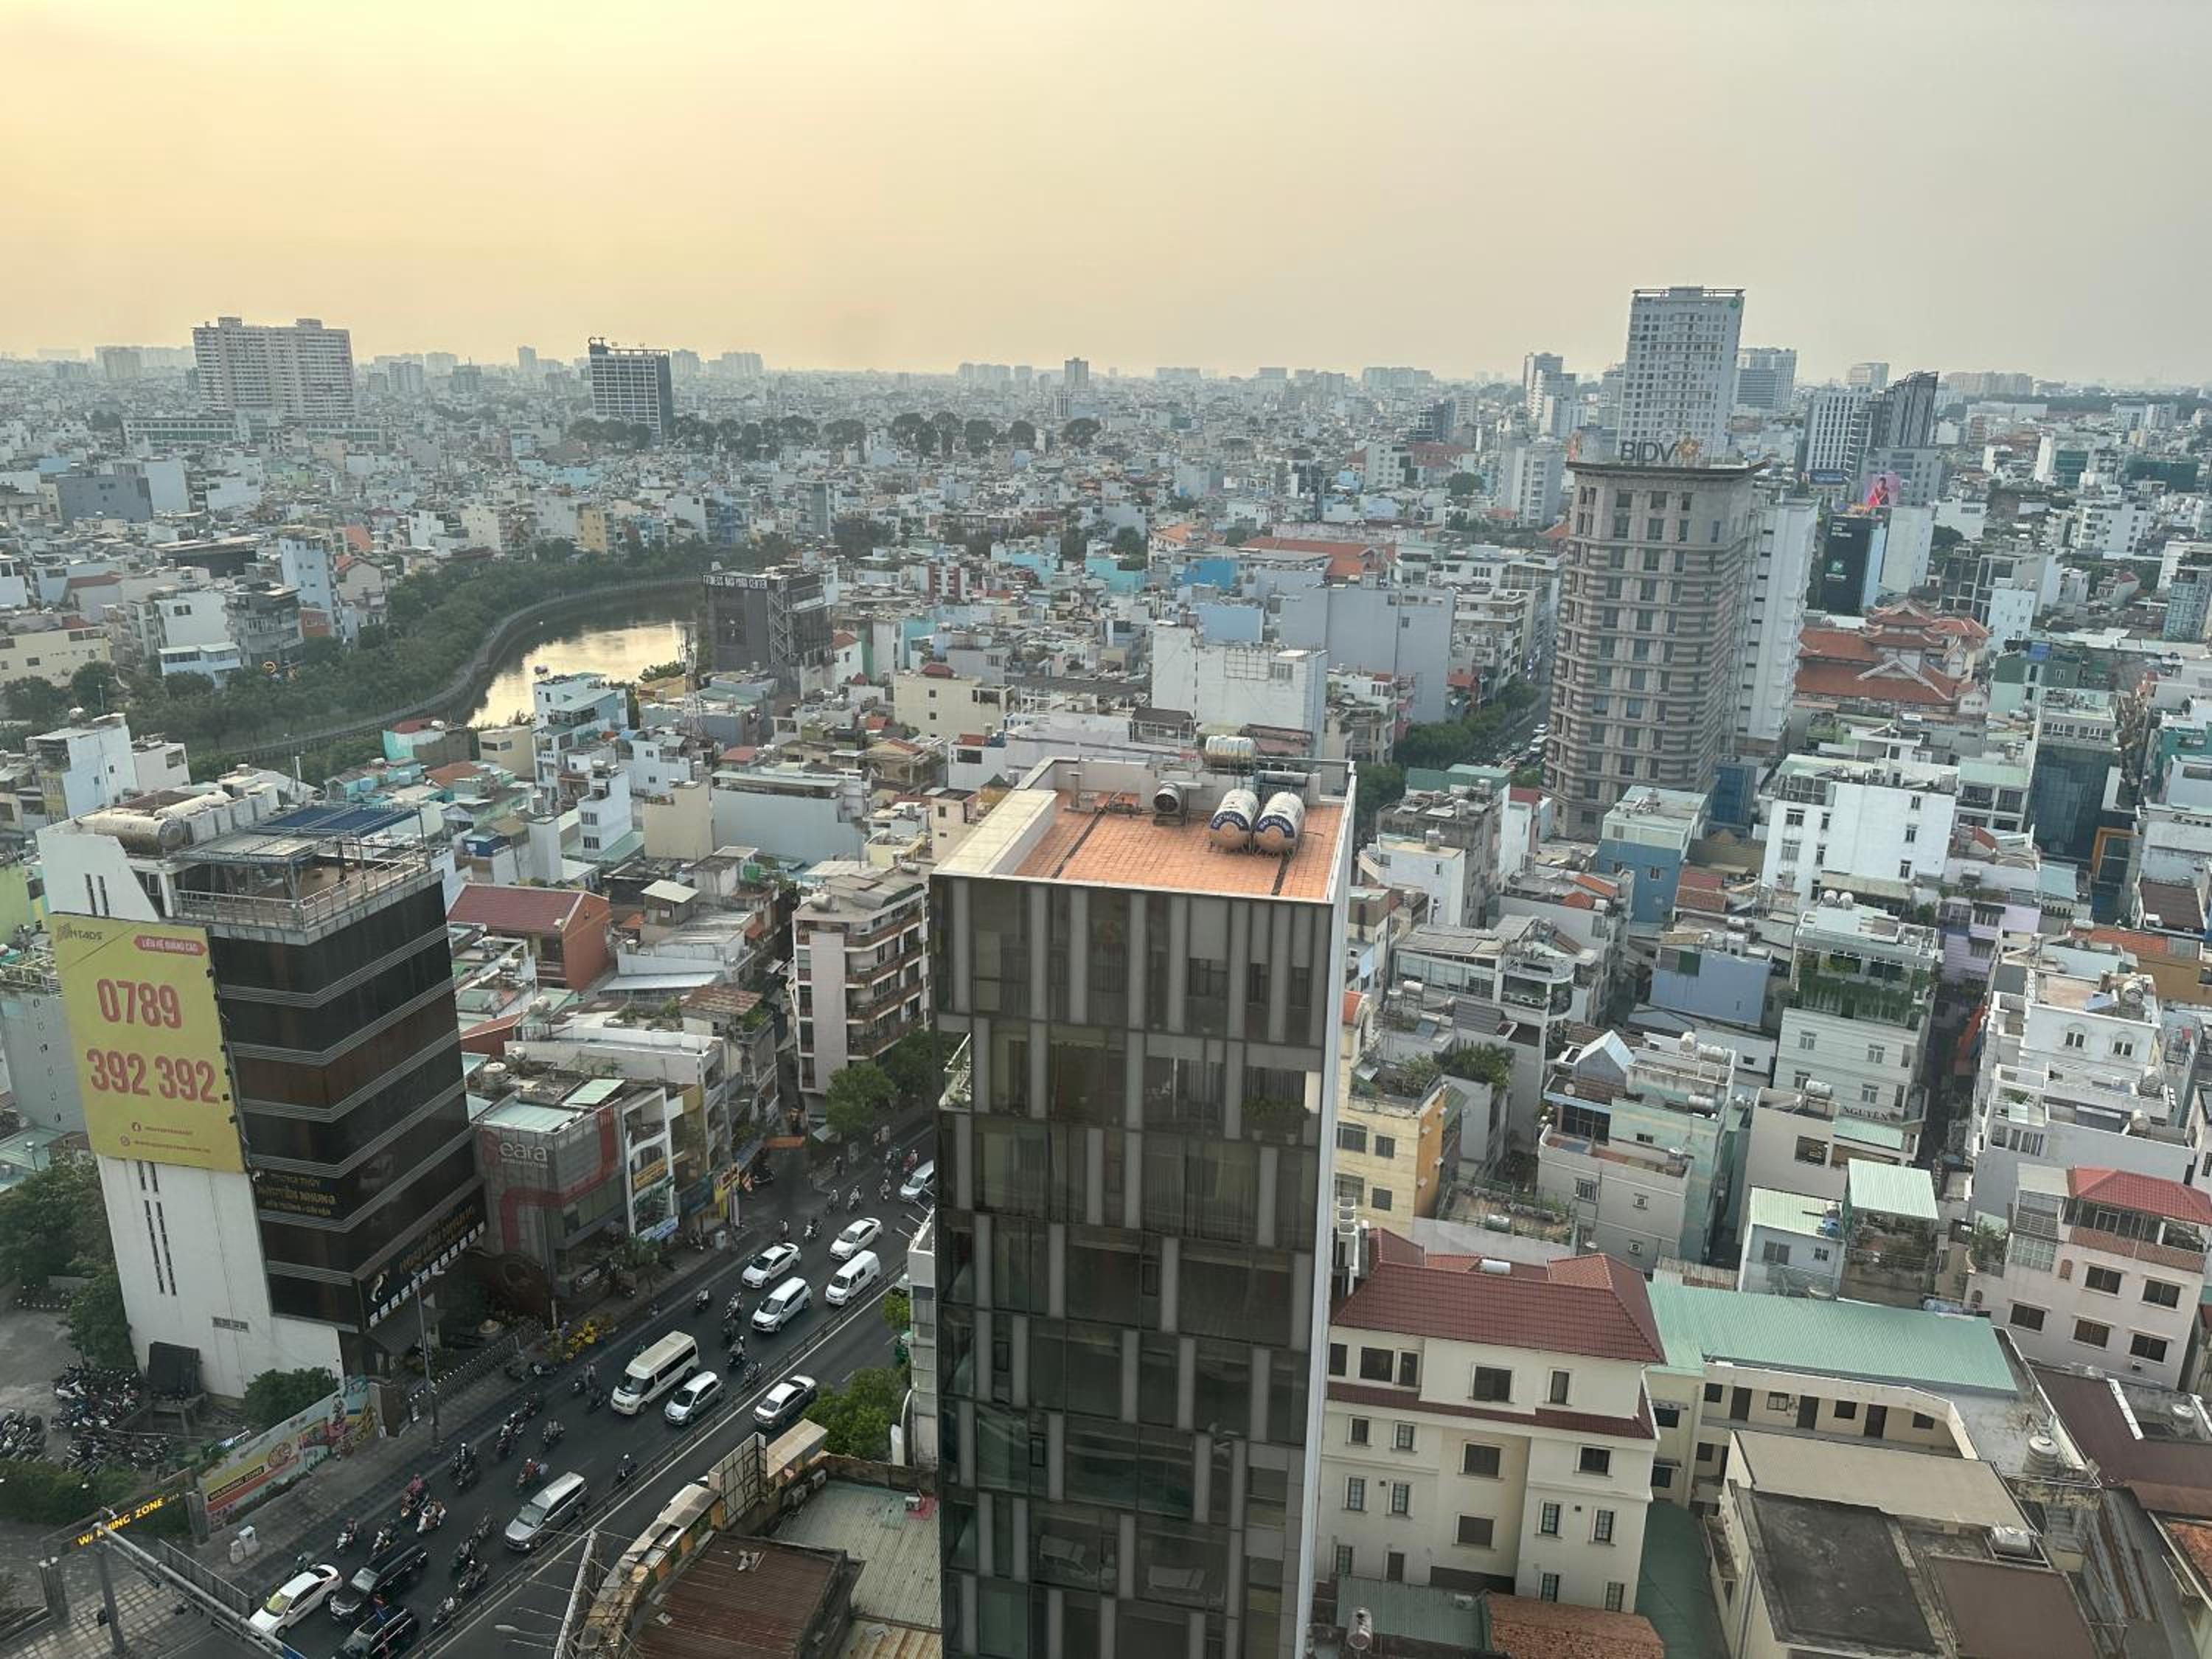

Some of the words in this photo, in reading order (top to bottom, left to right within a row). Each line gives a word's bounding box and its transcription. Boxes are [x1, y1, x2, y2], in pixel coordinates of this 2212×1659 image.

[1620, 441, 1676, 462] BIDV
[97, 978, 182, 1029] 0789
[86, 1048, 150, 1096] 392
[154, 1055, 220, 1105] 392
[135, 1498, 164, 1519] ZONE
